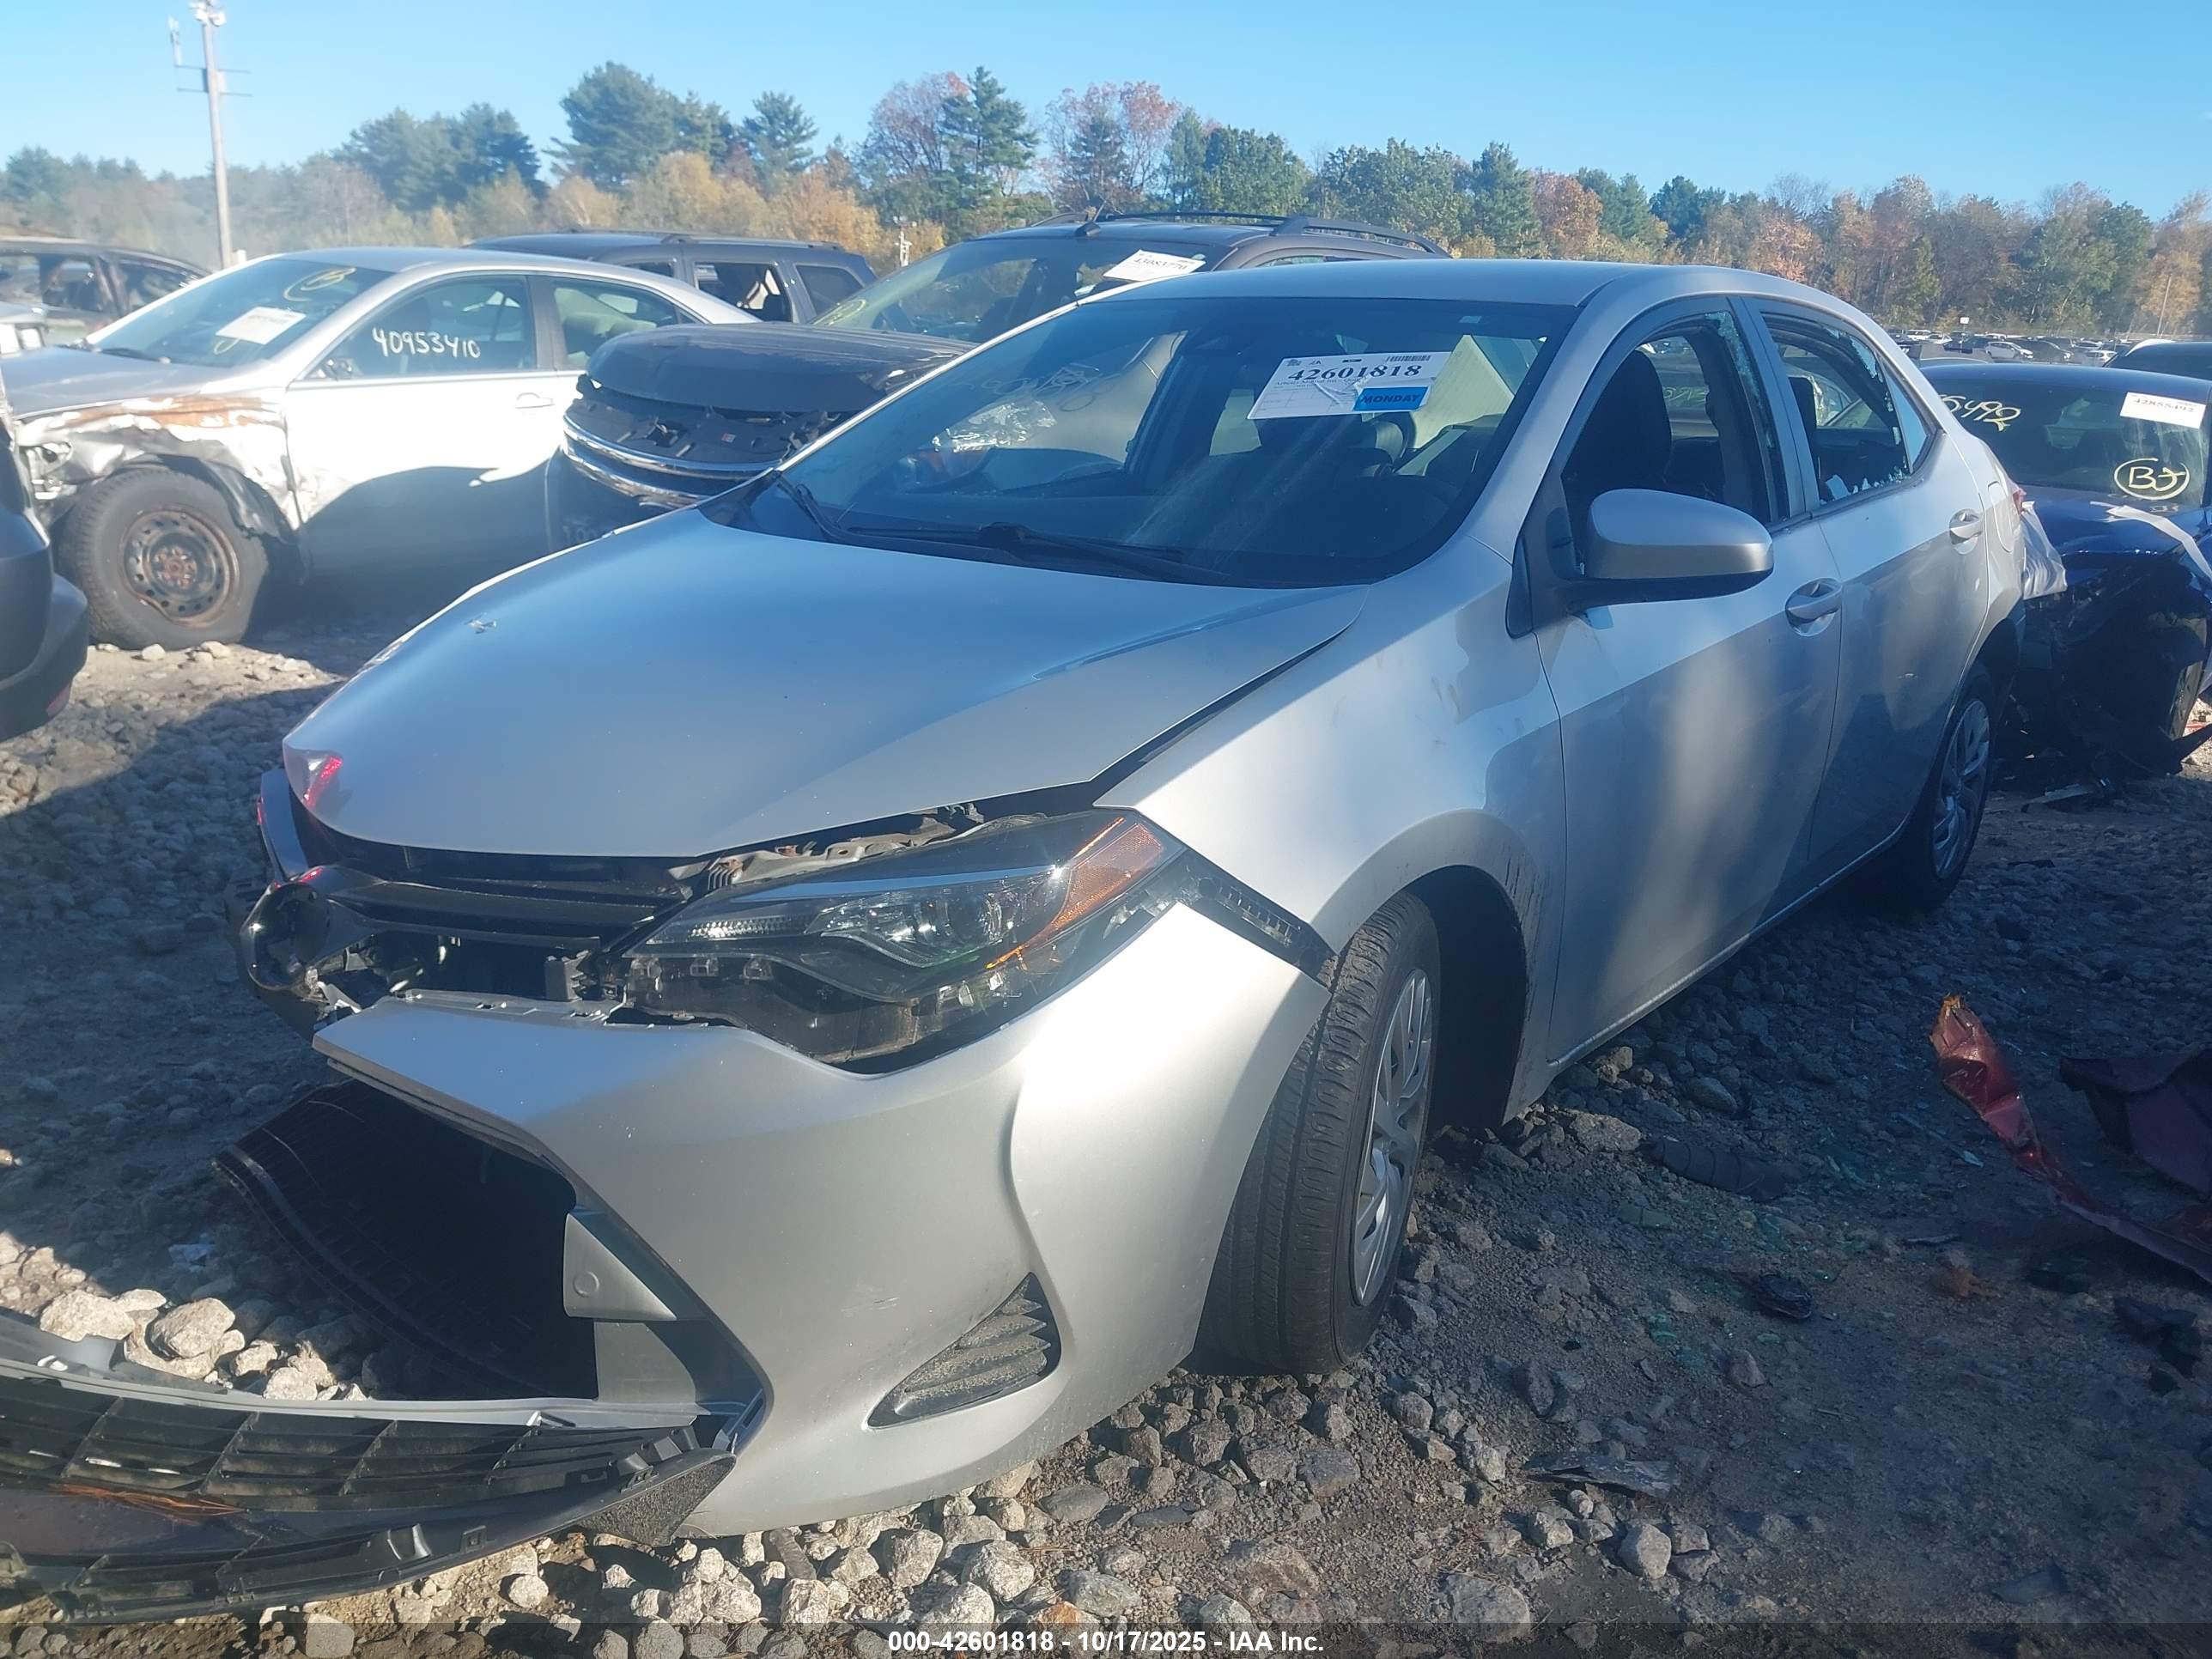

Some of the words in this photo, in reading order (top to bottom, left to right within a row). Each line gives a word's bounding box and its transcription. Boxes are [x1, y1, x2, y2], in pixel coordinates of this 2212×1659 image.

[372, 326, 482, 358] 40953410
[1288, 364, 1423, 381] 42601818
[1359, 394, 1421, 404] MONDAY
